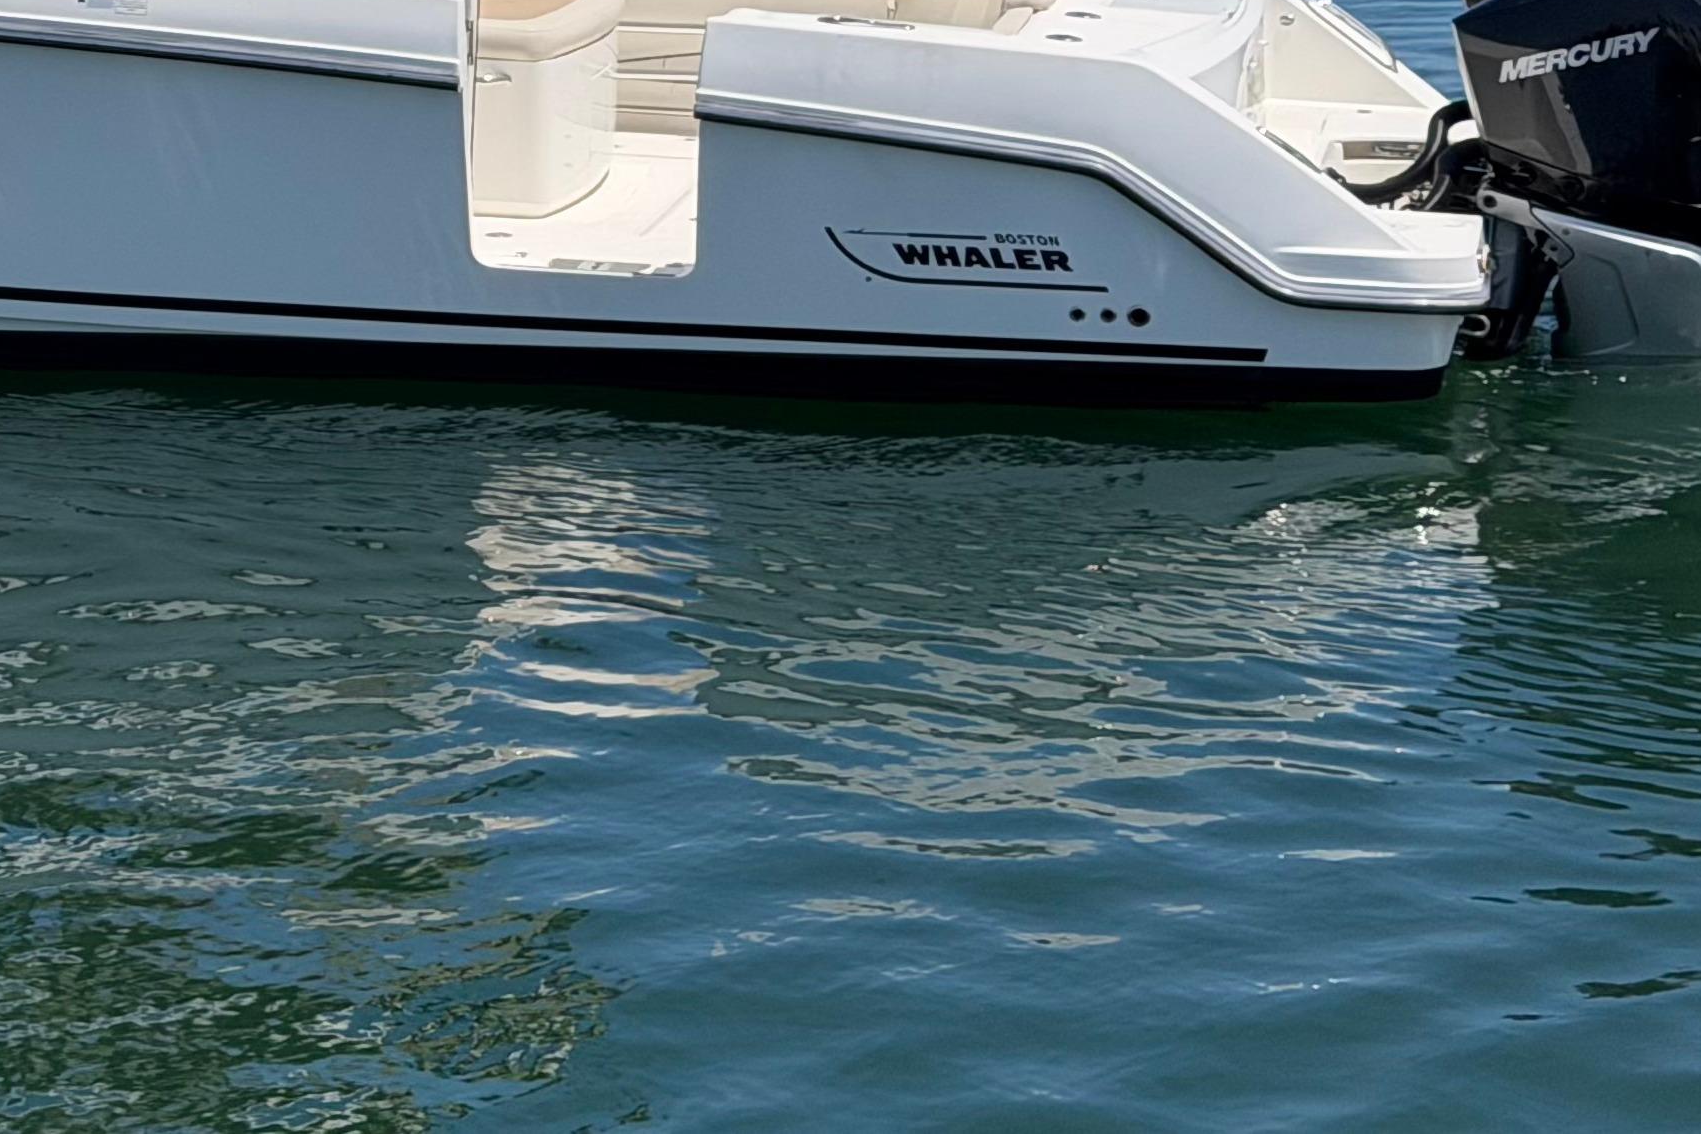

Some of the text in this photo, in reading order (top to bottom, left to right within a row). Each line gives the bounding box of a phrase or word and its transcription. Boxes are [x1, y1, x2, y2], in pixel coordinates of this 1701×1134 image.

[1499, 27, 1660, 83] MERCURY
[994, 233, 1060, 247] BOSTON
[892, 243, 1073, 272] WHALER
